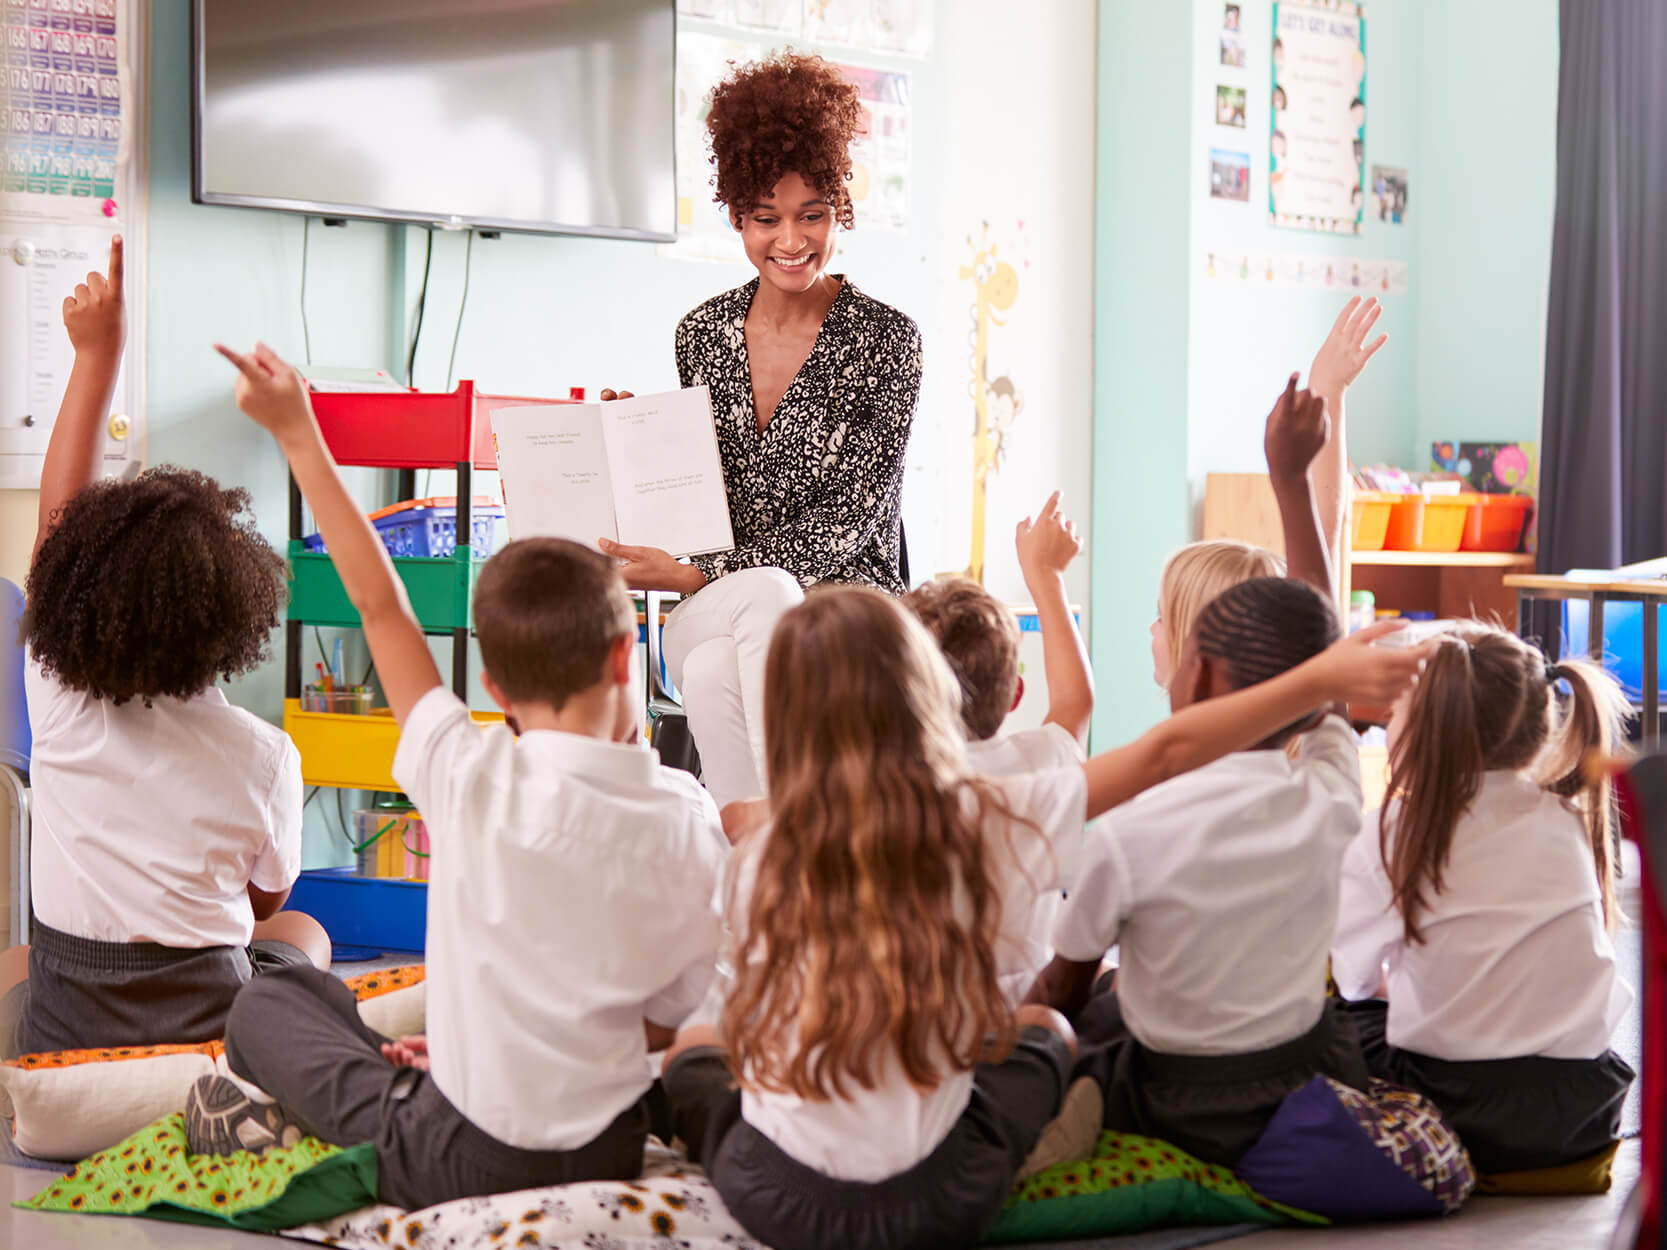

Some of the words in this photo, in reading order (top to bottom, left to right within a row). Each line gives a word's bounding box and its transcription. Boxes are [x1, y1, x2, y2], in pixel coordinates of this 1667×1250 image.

[8, 28, 26, 48] 166
[30, 31, 48, 50] 167
[74, 35, 95, 57] 169
[10, 69, 29, 89] 176
[33, 72, 52, 92] 177
[55, 74, 74, 94] 178
[77, 76, 98, 97] 179
[12, 111, 30, 131] 186
[34, 113, 52, 133] 187
[78, 117, 99, 137] 189
